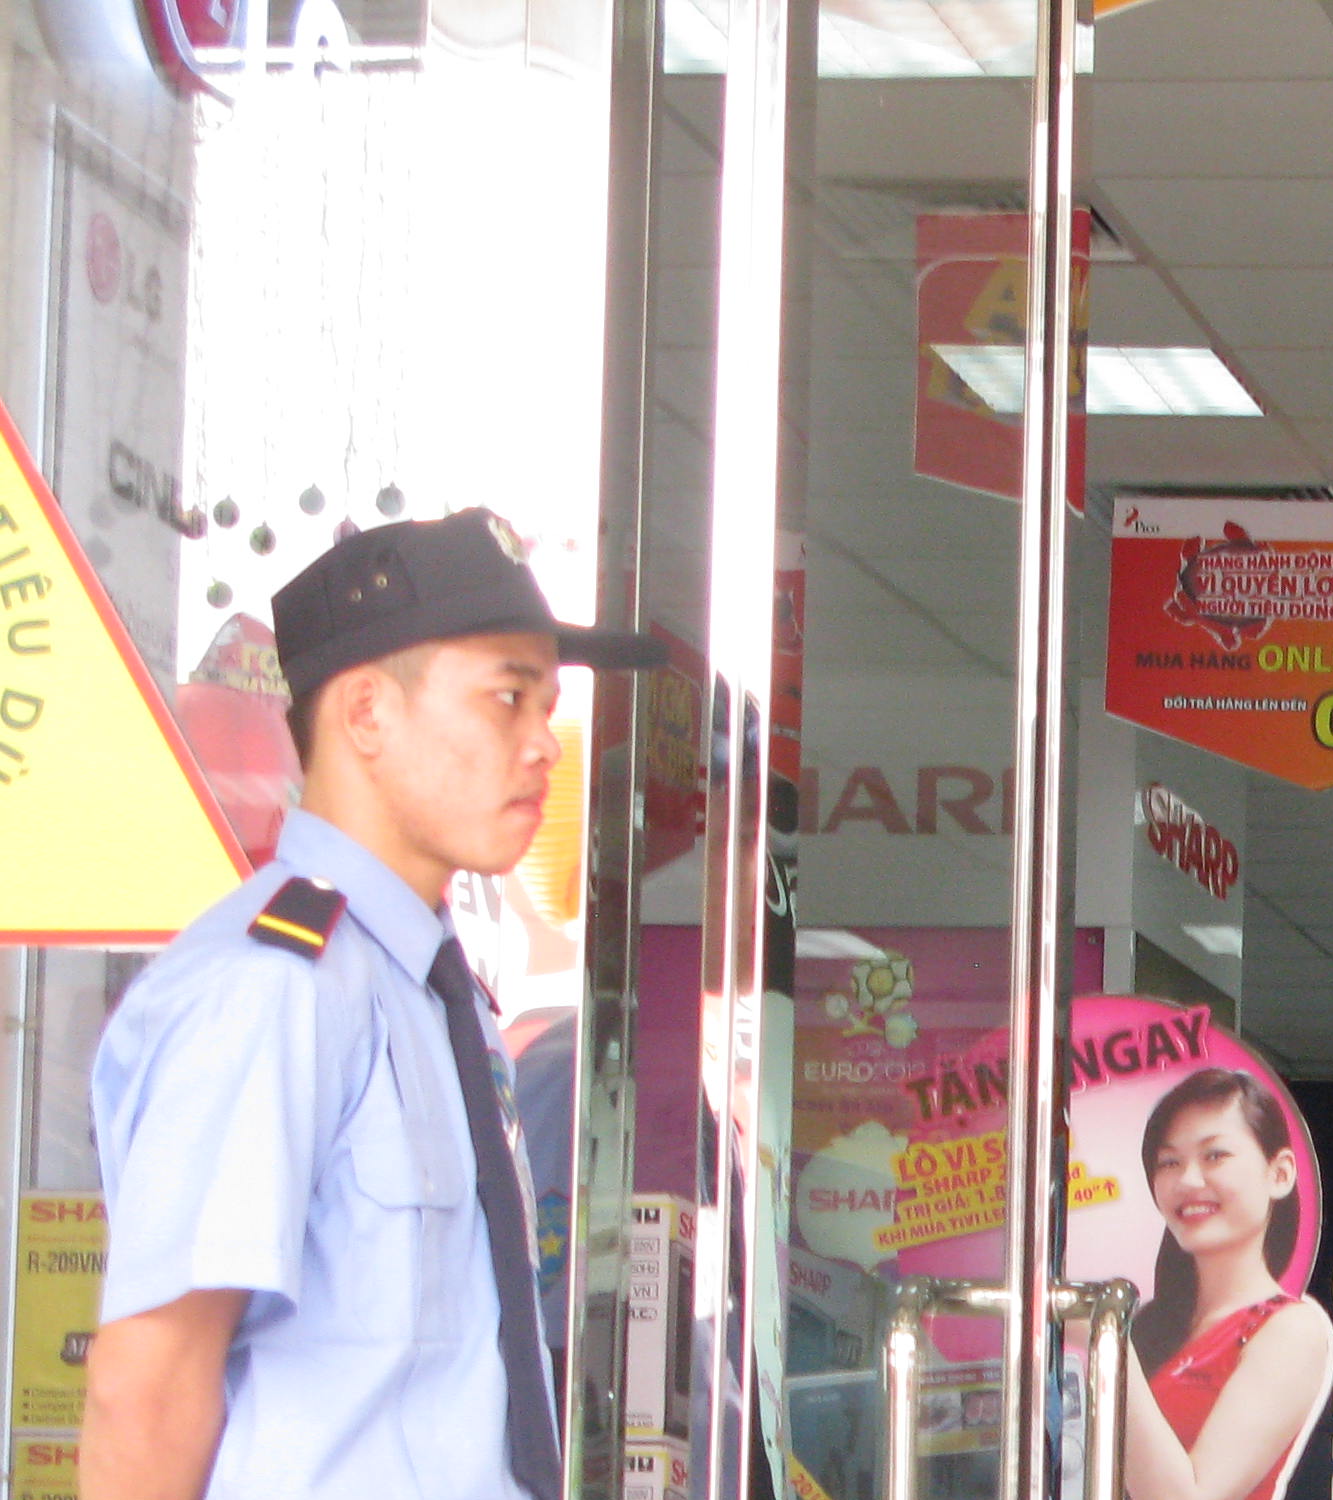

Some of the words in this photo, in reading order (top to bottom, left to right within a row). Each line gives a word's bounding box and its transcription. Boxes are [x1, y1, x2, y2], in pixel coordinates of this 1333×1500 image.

[1136, 653, 1184, 670] MUA
[1189, 648, 1251, 671] HÀNG
[1143, 781, 1239, 900] SHARP
[905, 1057, 1010, 1128] TẶN
[922, 1169, 992, 1197] SHARP
[30, 1200, 109, 1224] SHA
